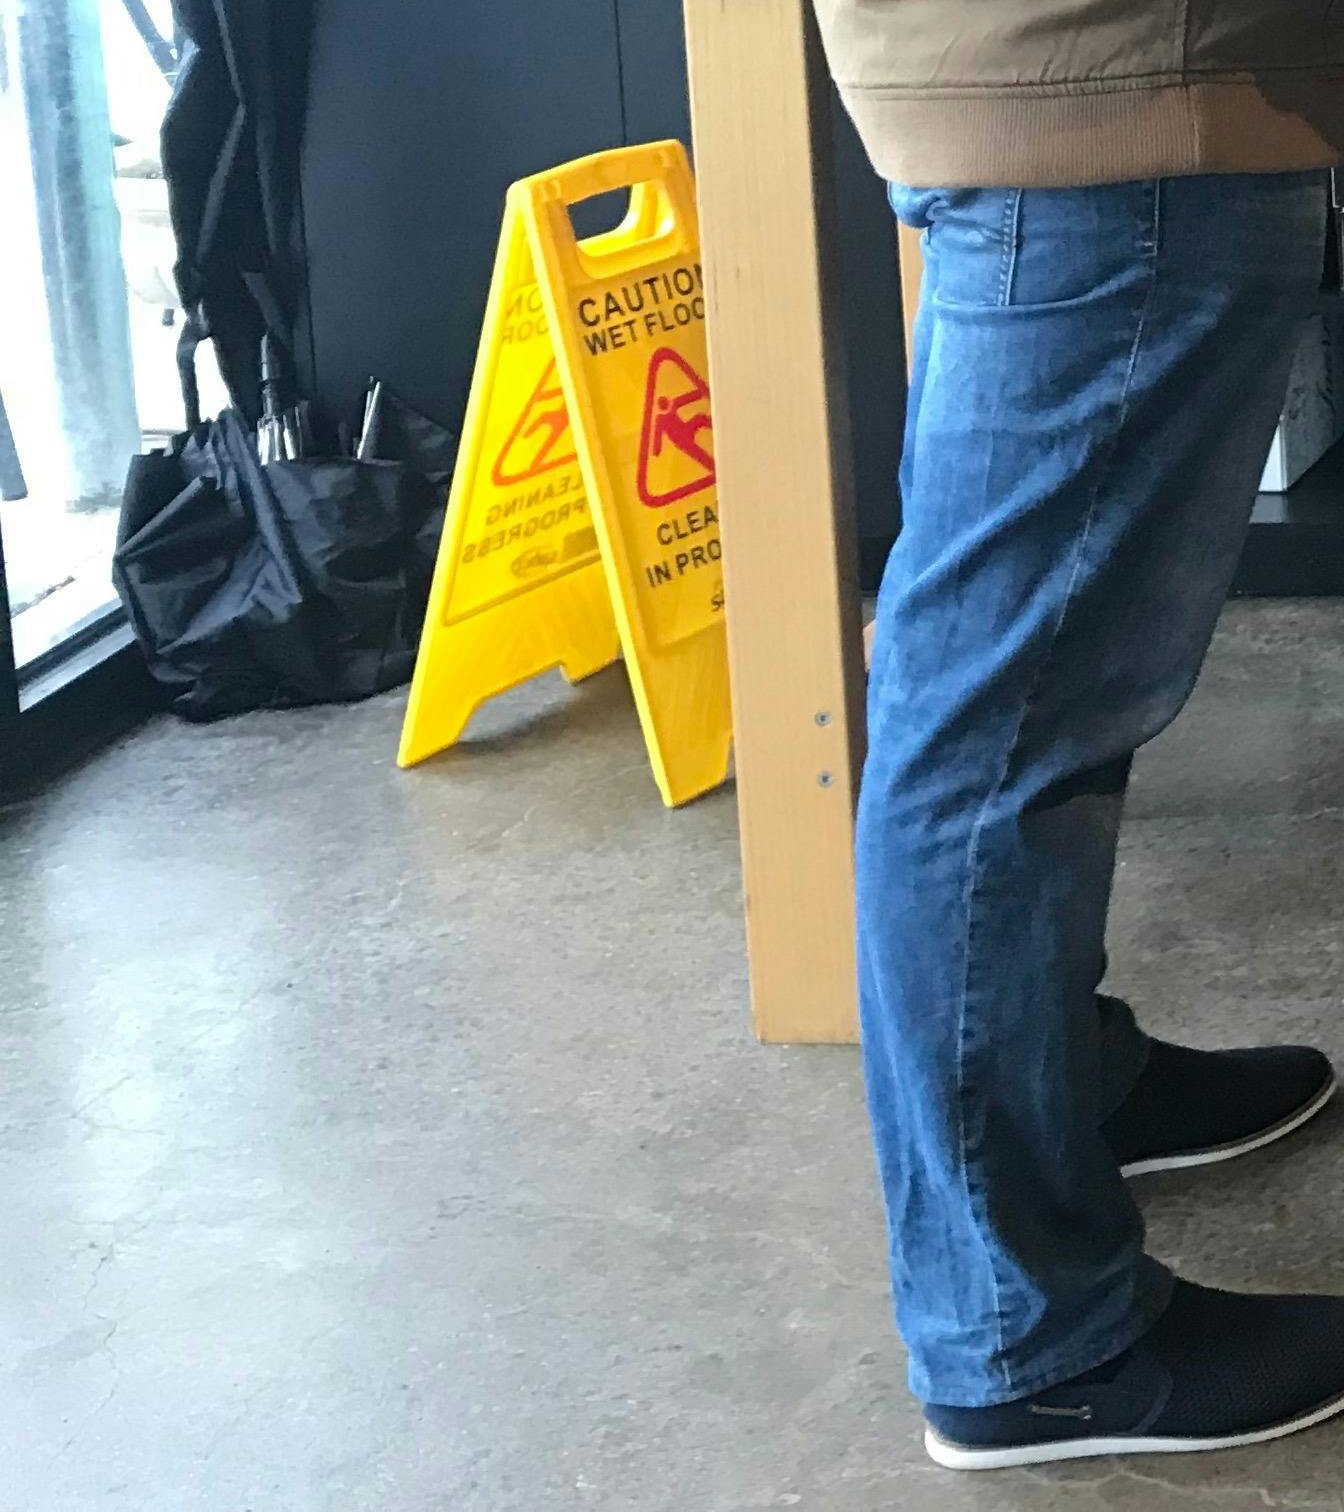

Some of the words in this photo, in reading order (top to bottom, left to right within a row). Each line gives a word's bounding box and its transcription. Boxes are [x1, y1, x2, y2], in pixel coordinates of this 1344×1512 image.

[584, 318, 637, 356] WET
[643, 296, 705, 337] FLOO
[645, 560, 672, 588] IN
